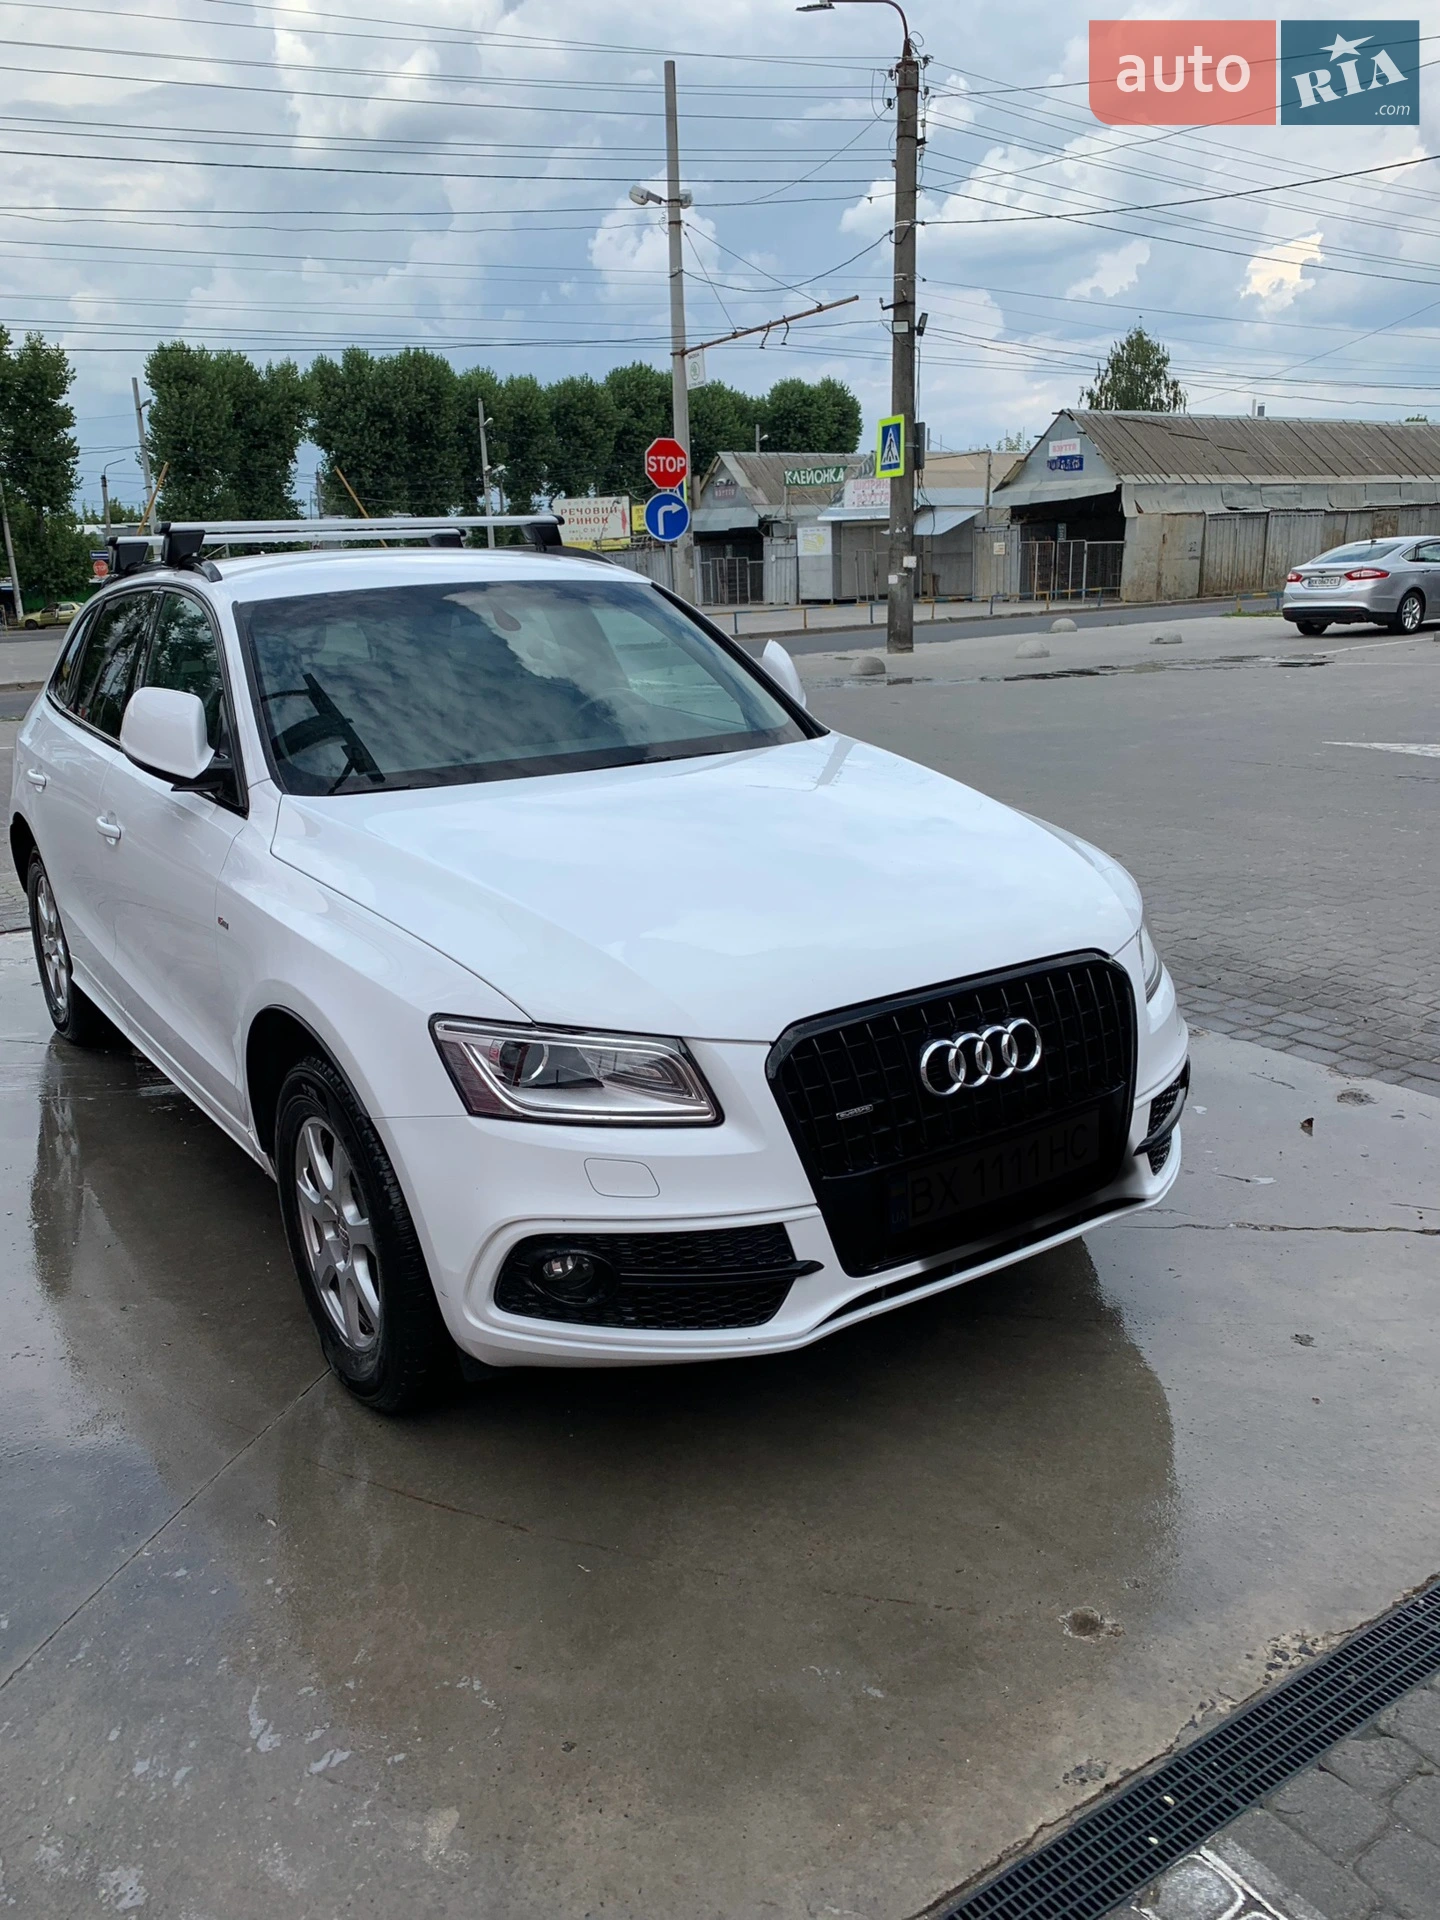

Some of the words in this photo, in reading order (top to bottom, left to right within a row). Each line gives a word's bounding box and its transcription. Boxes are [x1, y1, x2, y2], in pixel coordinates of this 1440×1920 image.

[647, 455, 686, 473] STOP
[784, 467, 845, 485] КЛЕЙОНКА
[568, 516, 609, 525] РИНОК
[911, 1167, 960, 1218] BX
[972, 1140, 1040, 1197] 1111
[1049, 1123, 1089, 1173] HC
